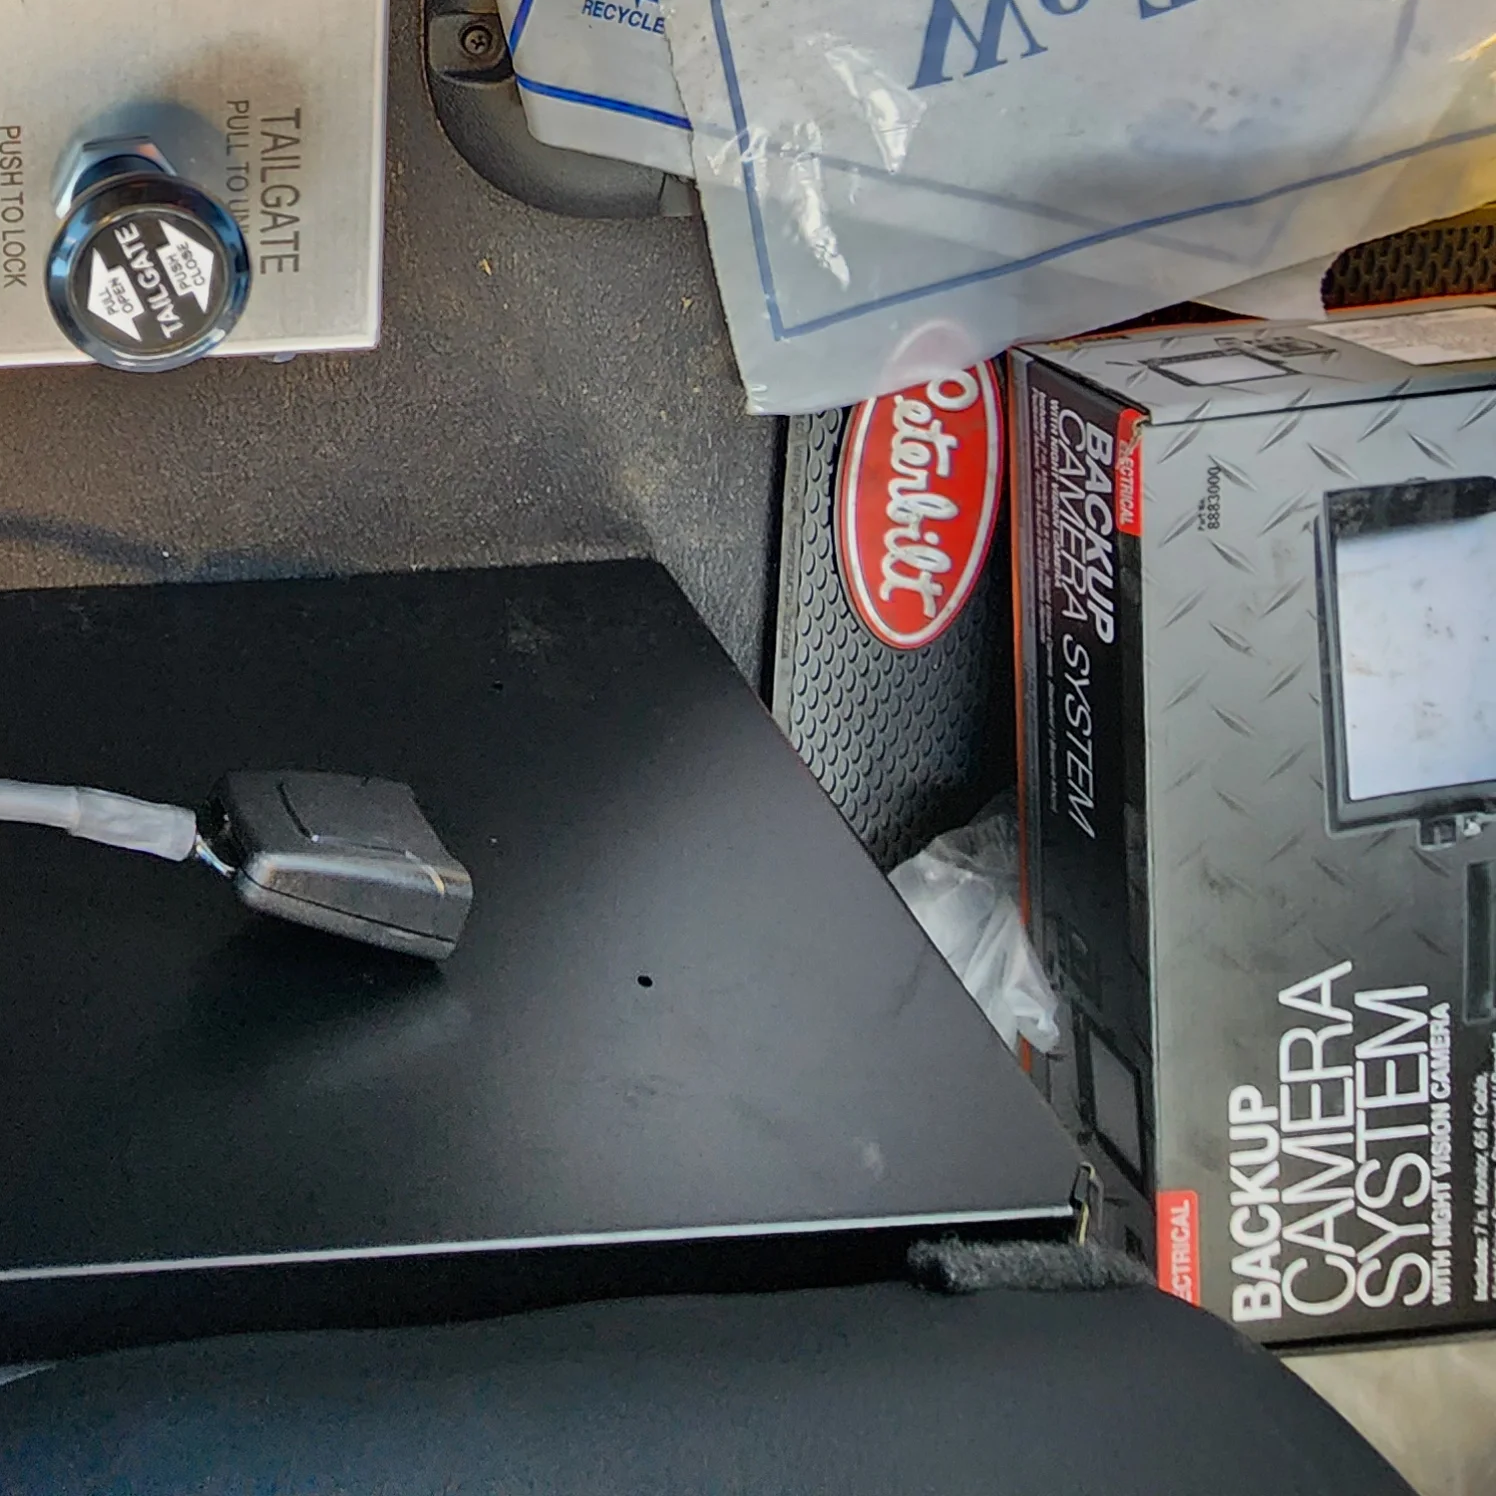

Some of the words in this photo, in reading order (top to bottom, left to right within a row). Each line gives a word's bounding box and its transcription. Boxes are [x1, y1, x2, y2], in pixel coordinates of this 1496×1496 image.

[226, 99, 249, 156] PULL
[0, 191, 24, 223] TO
[226, 162, 249, 192] TO
[260, 107, 301, 275] TAILGATE
[2, 229, 27, 289] LOCK
[113, 222, 183, 340] TAILGATE
[166, 254, 192, 290] PUSH
[177, 241, 205, 287] CLOSE
[98, 286, 118, 316] PULL
[109, 276, 134, 314] OPEN
[1050, 399, 1059, 435] WITH
[1050, 436, 1060, 480] NIGHT
[1051, 482, 1061, 527] VISION
[1058, 409, 1089, 622] CAMERA
[1206, 466, 1221, 530] 8883000
[1083, 421, 1114, 644] BACKUP
[1061, 634, 1096, 840] SYSTEM
[1430, 1002, 1451, 1099] CAMERA
[1279, 960, 1356, 1316] CAMERA
[1355, 985, 1430, 1307] SYSTEM
[1430, 1103, 1452, 1178] VISION
[1229, 1084, 1280, 1321] BACKUP
[1431, 1180, 1452, 1247] NIGHT
[1169, 1199, 1192, 1303] ECTRICAL
[1431, 1249, 1452, 1306] WITH
